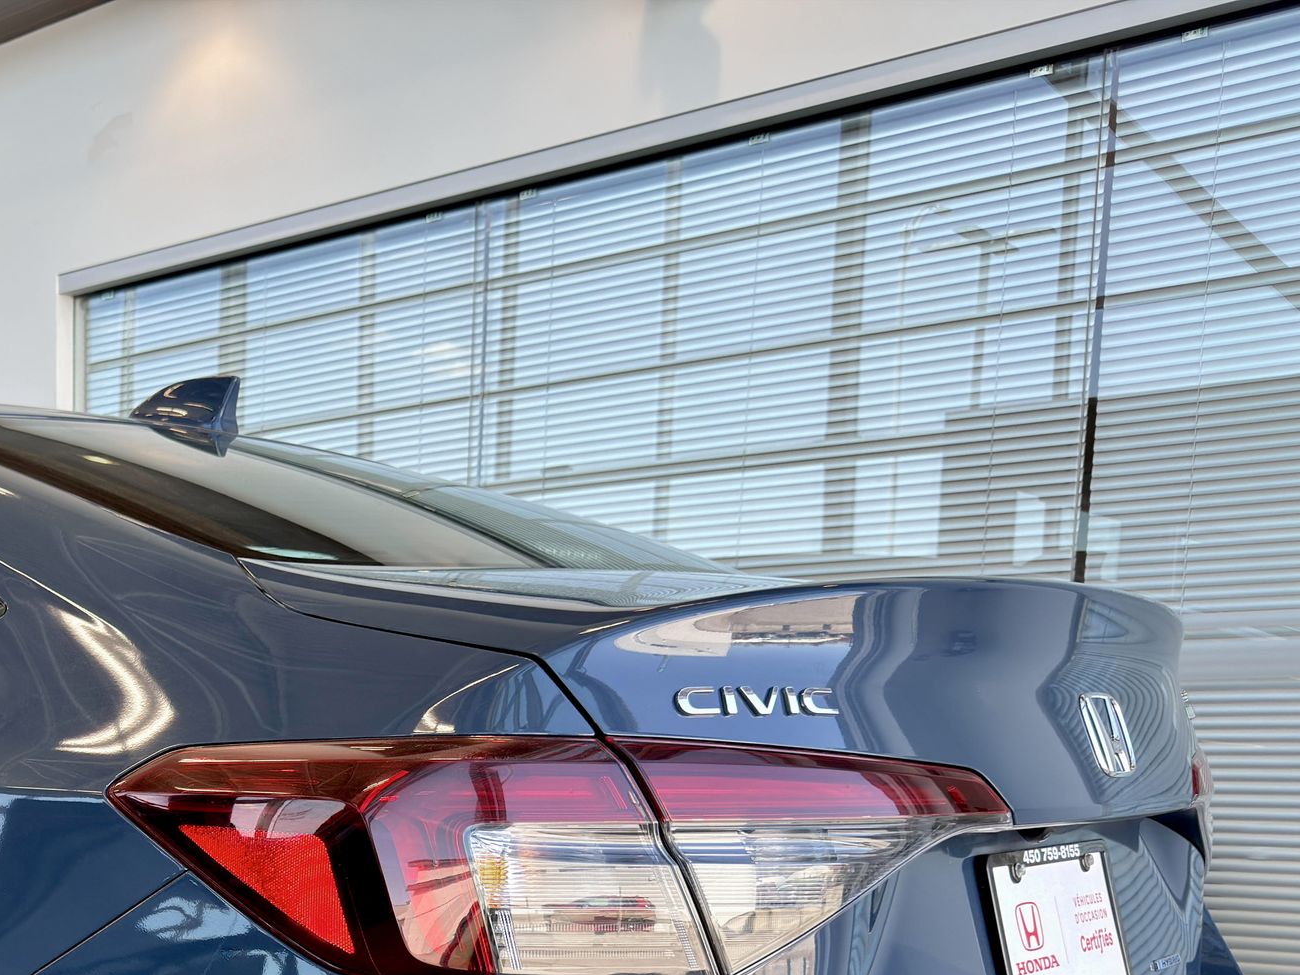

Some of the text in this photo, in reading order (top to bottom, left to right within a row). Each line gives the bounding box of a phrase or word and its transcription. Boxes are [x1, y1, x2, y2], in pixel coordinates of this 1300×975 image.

[673, 685, 840, 717] CIVIC
[1022, 843, 1080, 864] 450 759-8155
[1080, 928, 1114, 954] Certifiés
[1016, 954, 1060, 975] HONDA
